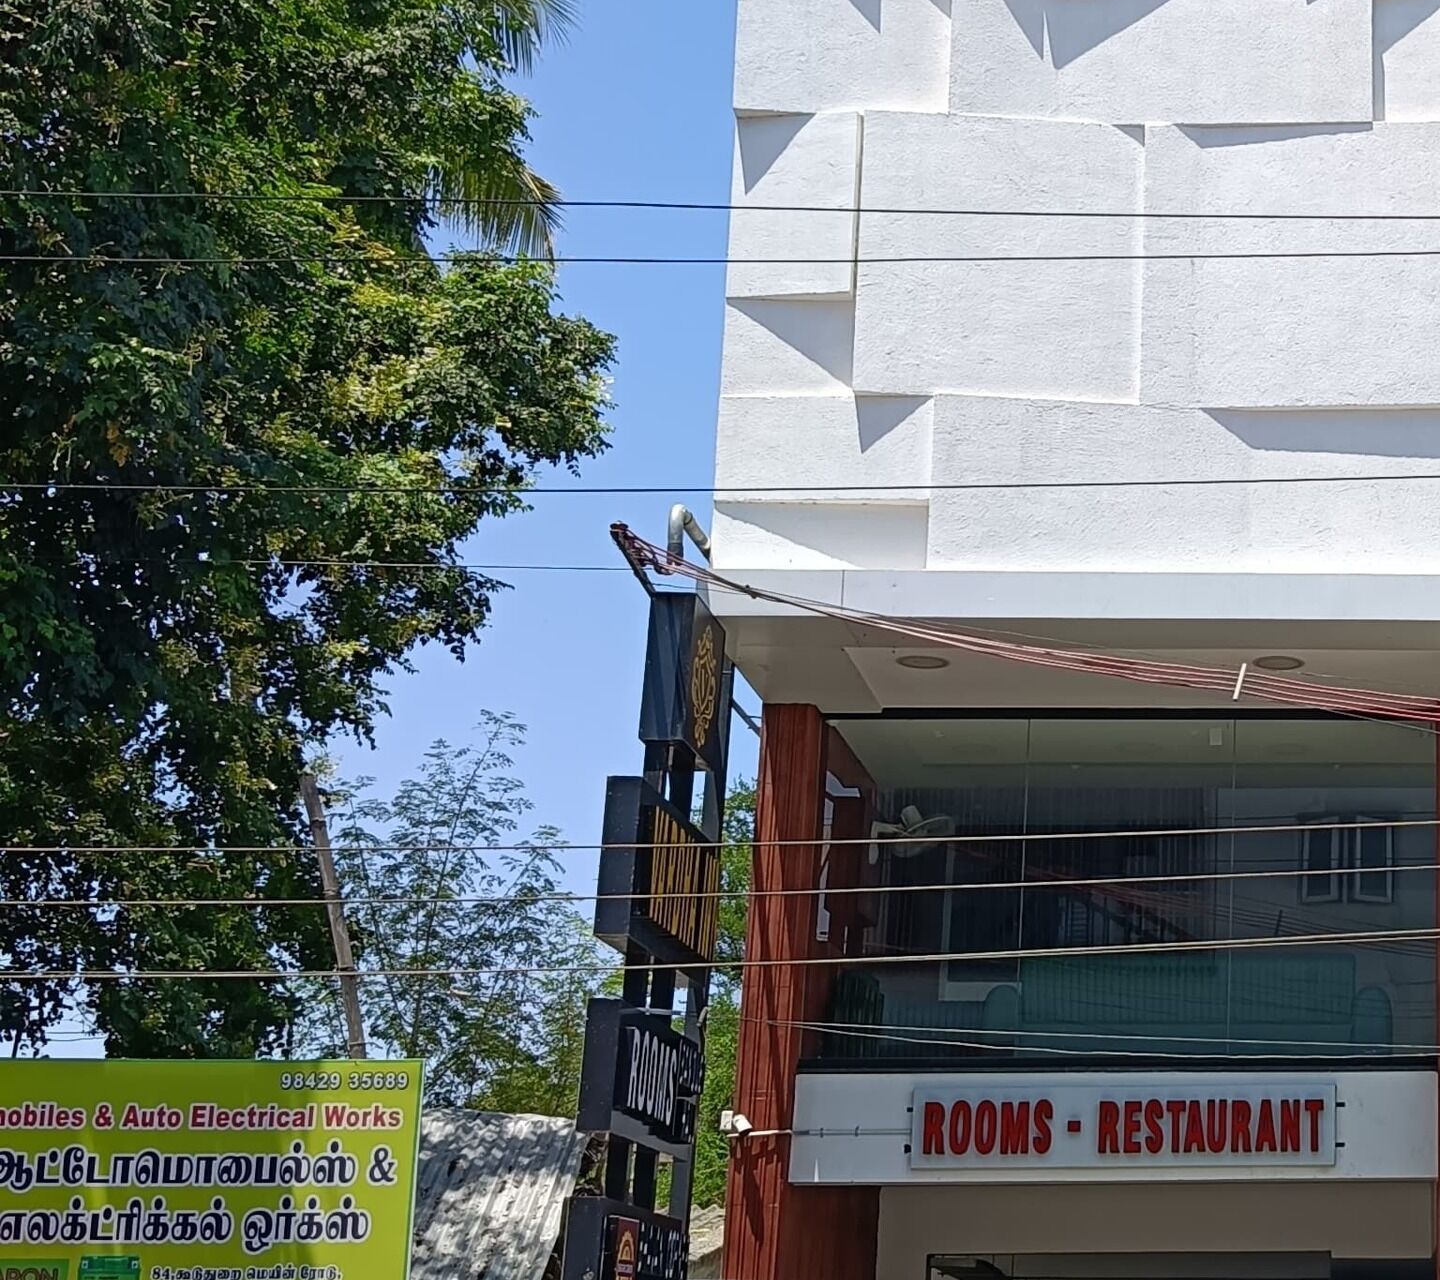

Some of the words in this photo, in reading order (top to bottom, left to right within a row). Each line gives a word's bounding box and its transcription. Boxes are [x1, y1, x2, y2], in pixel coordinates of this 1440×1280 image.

[281, 1071, 341, 1090] 98429
[348, 1071, 409, 1090] 35689
[626, 1026, 677, 1127] ROOMS
[0, 1104, 85, 1128] obiles
[95, 1104, 114, 1128] &
[122, 1104, 182, 1129] Auto
[190, 1104, 314, 1129] Electrical
[324, 1104, 401, 1128] Works
[922, 1098, 1053, 1156] ROOMS
[1097, 1098, 1325, 1154] RESTAURANT
[369, 1147, 396, 1183] &
